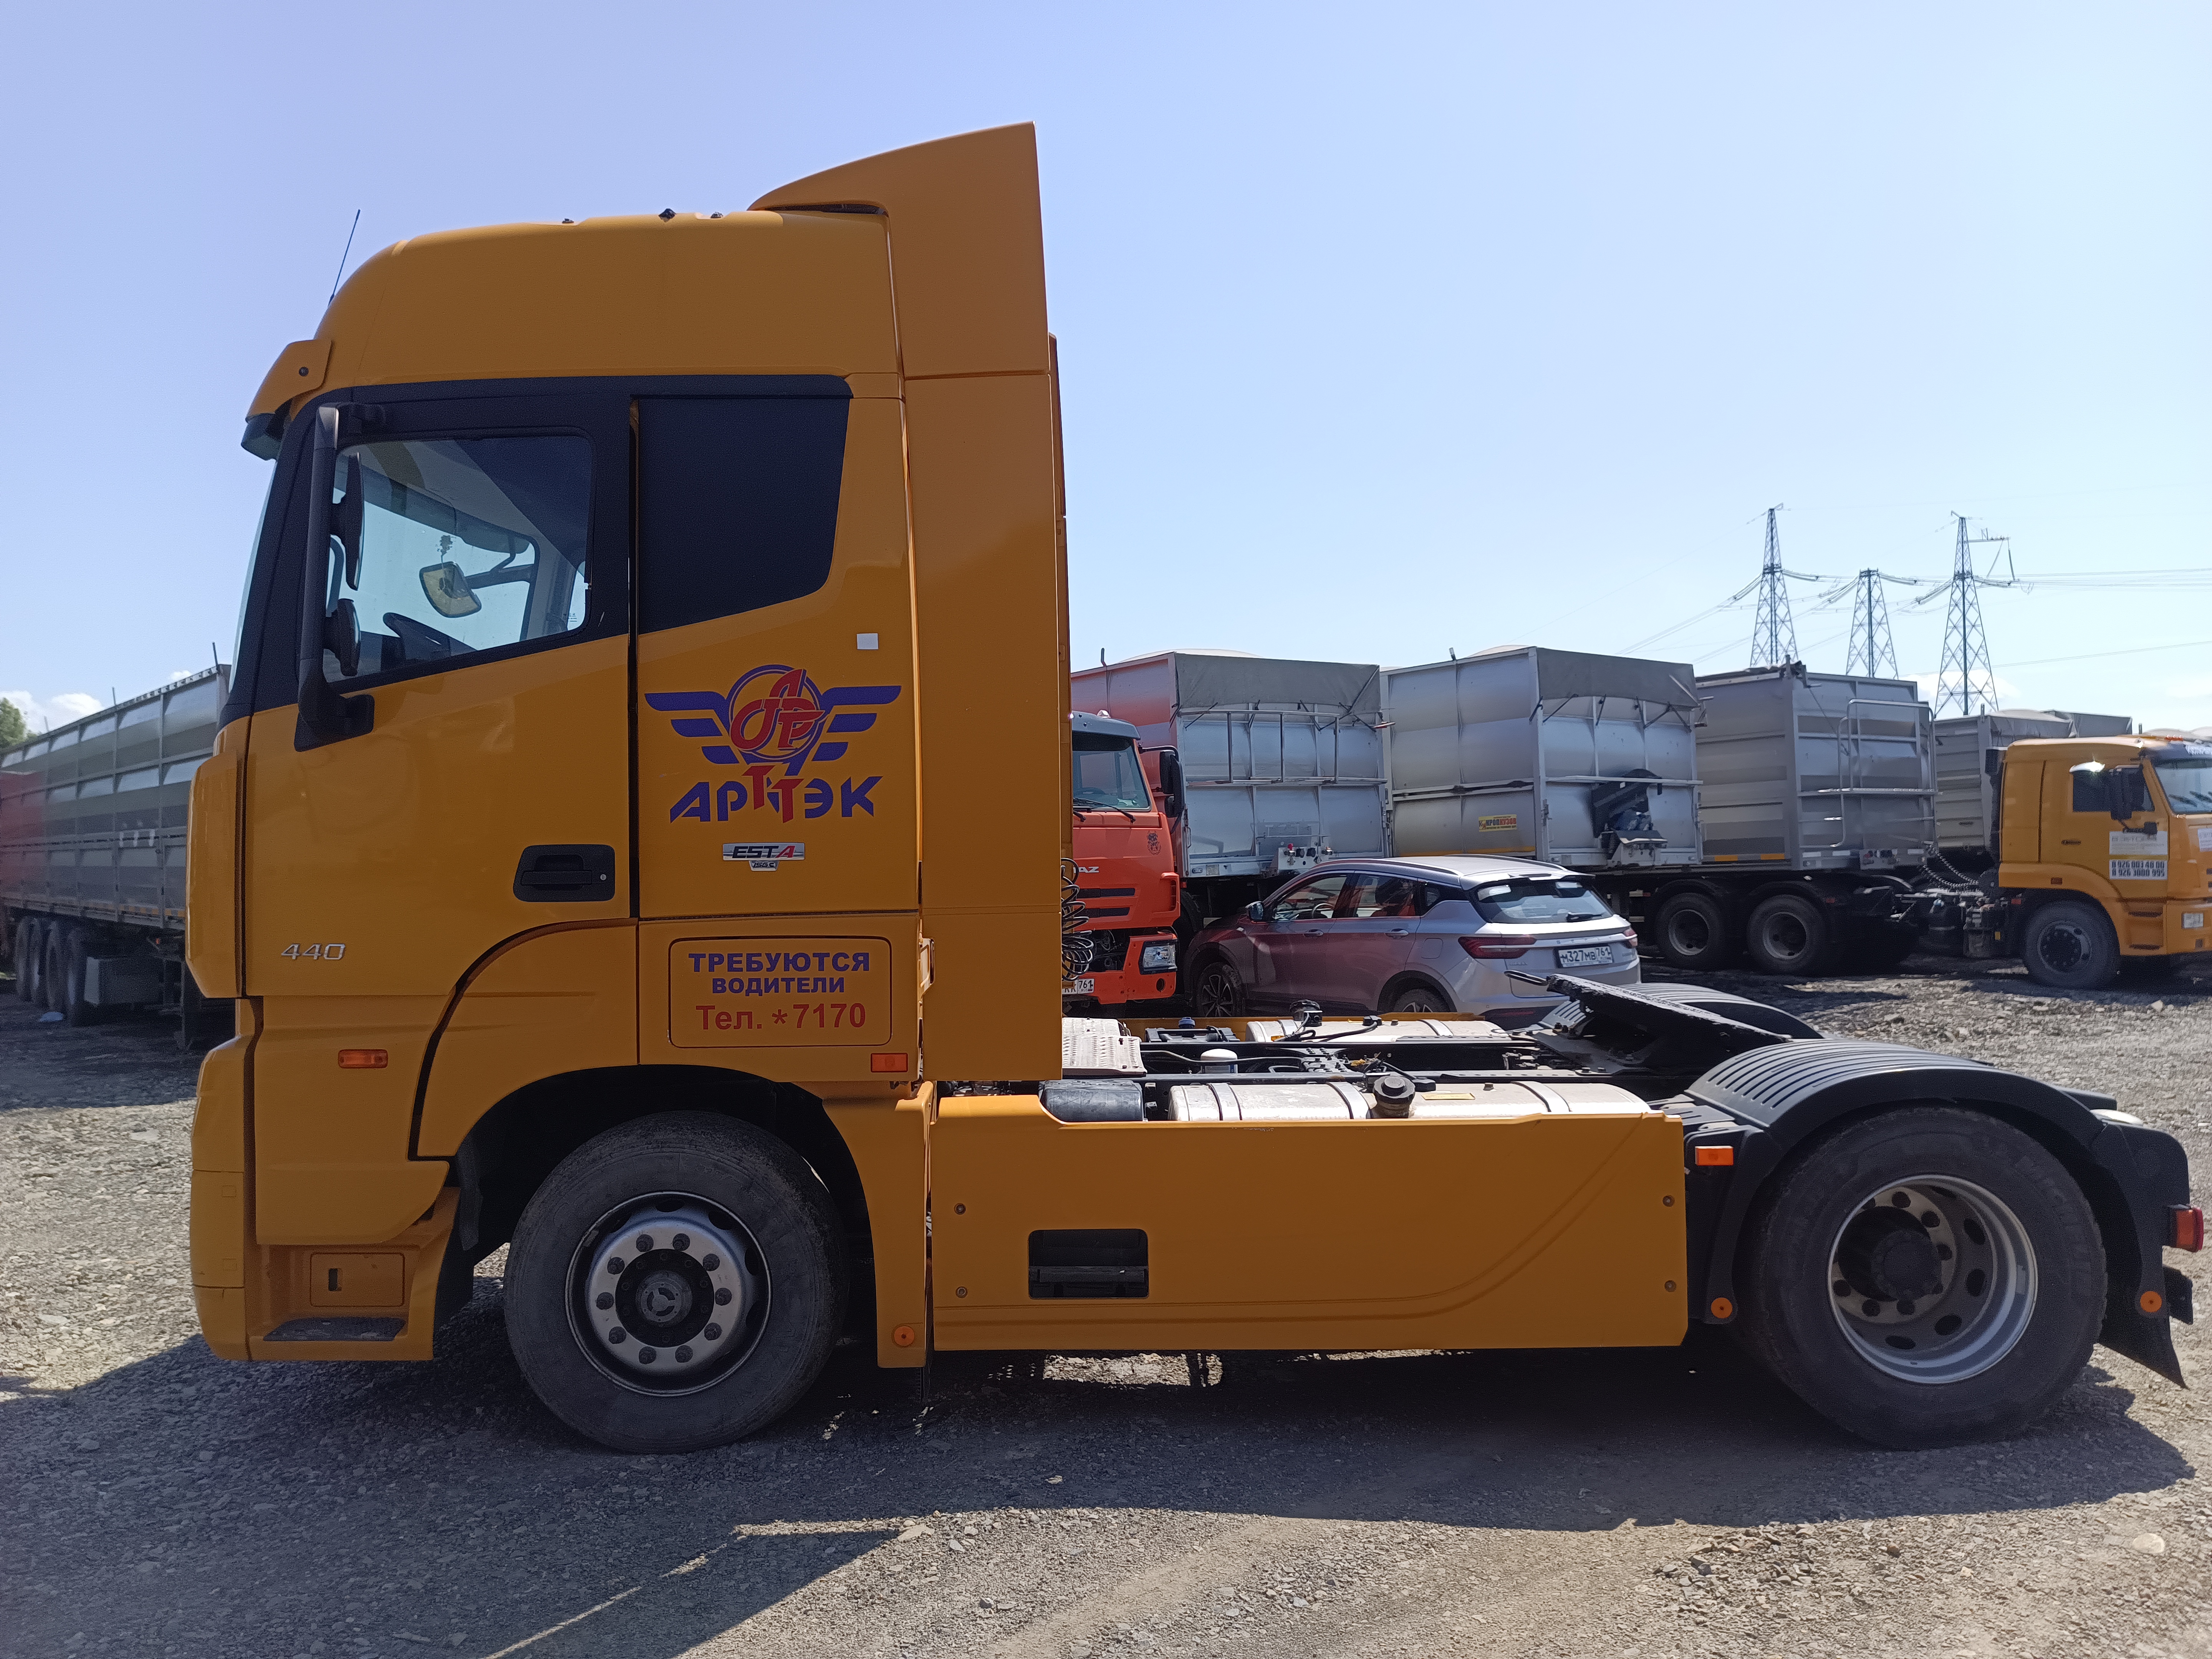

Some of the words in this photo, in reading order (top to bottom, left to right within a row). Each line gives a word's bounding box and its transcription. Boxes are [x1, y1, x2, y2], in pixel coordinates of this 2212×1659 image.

[732, 845, 796, 859] ESTA
[281, 943, 346, 960] 440
[1595, 947, 1609, 956] 761
[688, 952, 870, 972] ТРЕБУЮТСЯ
[712, 977, 845, 997] ВОДИТЕЛИ
[1079, 980, 1093, 989] 761
[695, 1005, 762, 1030] Тел.
